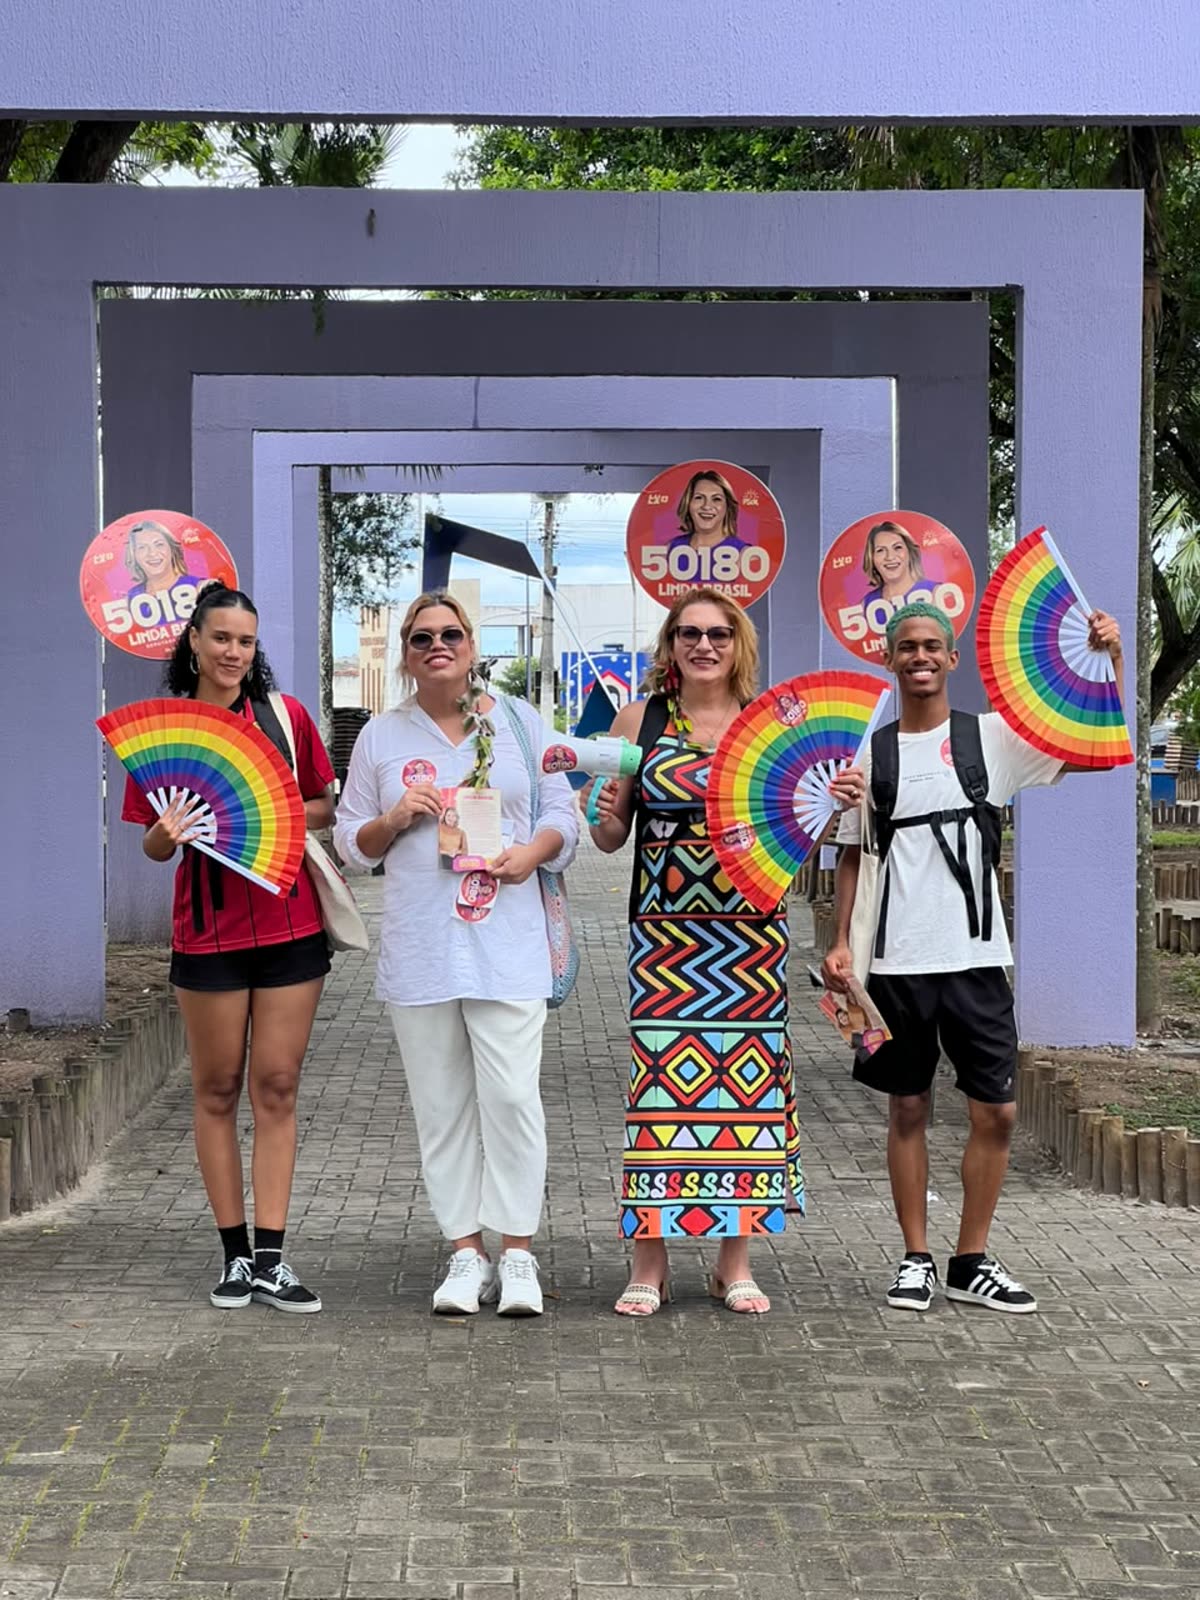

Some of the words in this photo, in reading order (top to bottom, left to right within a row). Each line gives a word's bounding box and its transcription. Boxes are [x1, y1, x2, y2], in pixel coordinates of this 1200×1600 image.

[640, 545, 770, 582] 50180
[101, 582, 200, 634] 5018
[128, 626, 170, 647] LINDA
[862, 636, 888, 654] LIN
